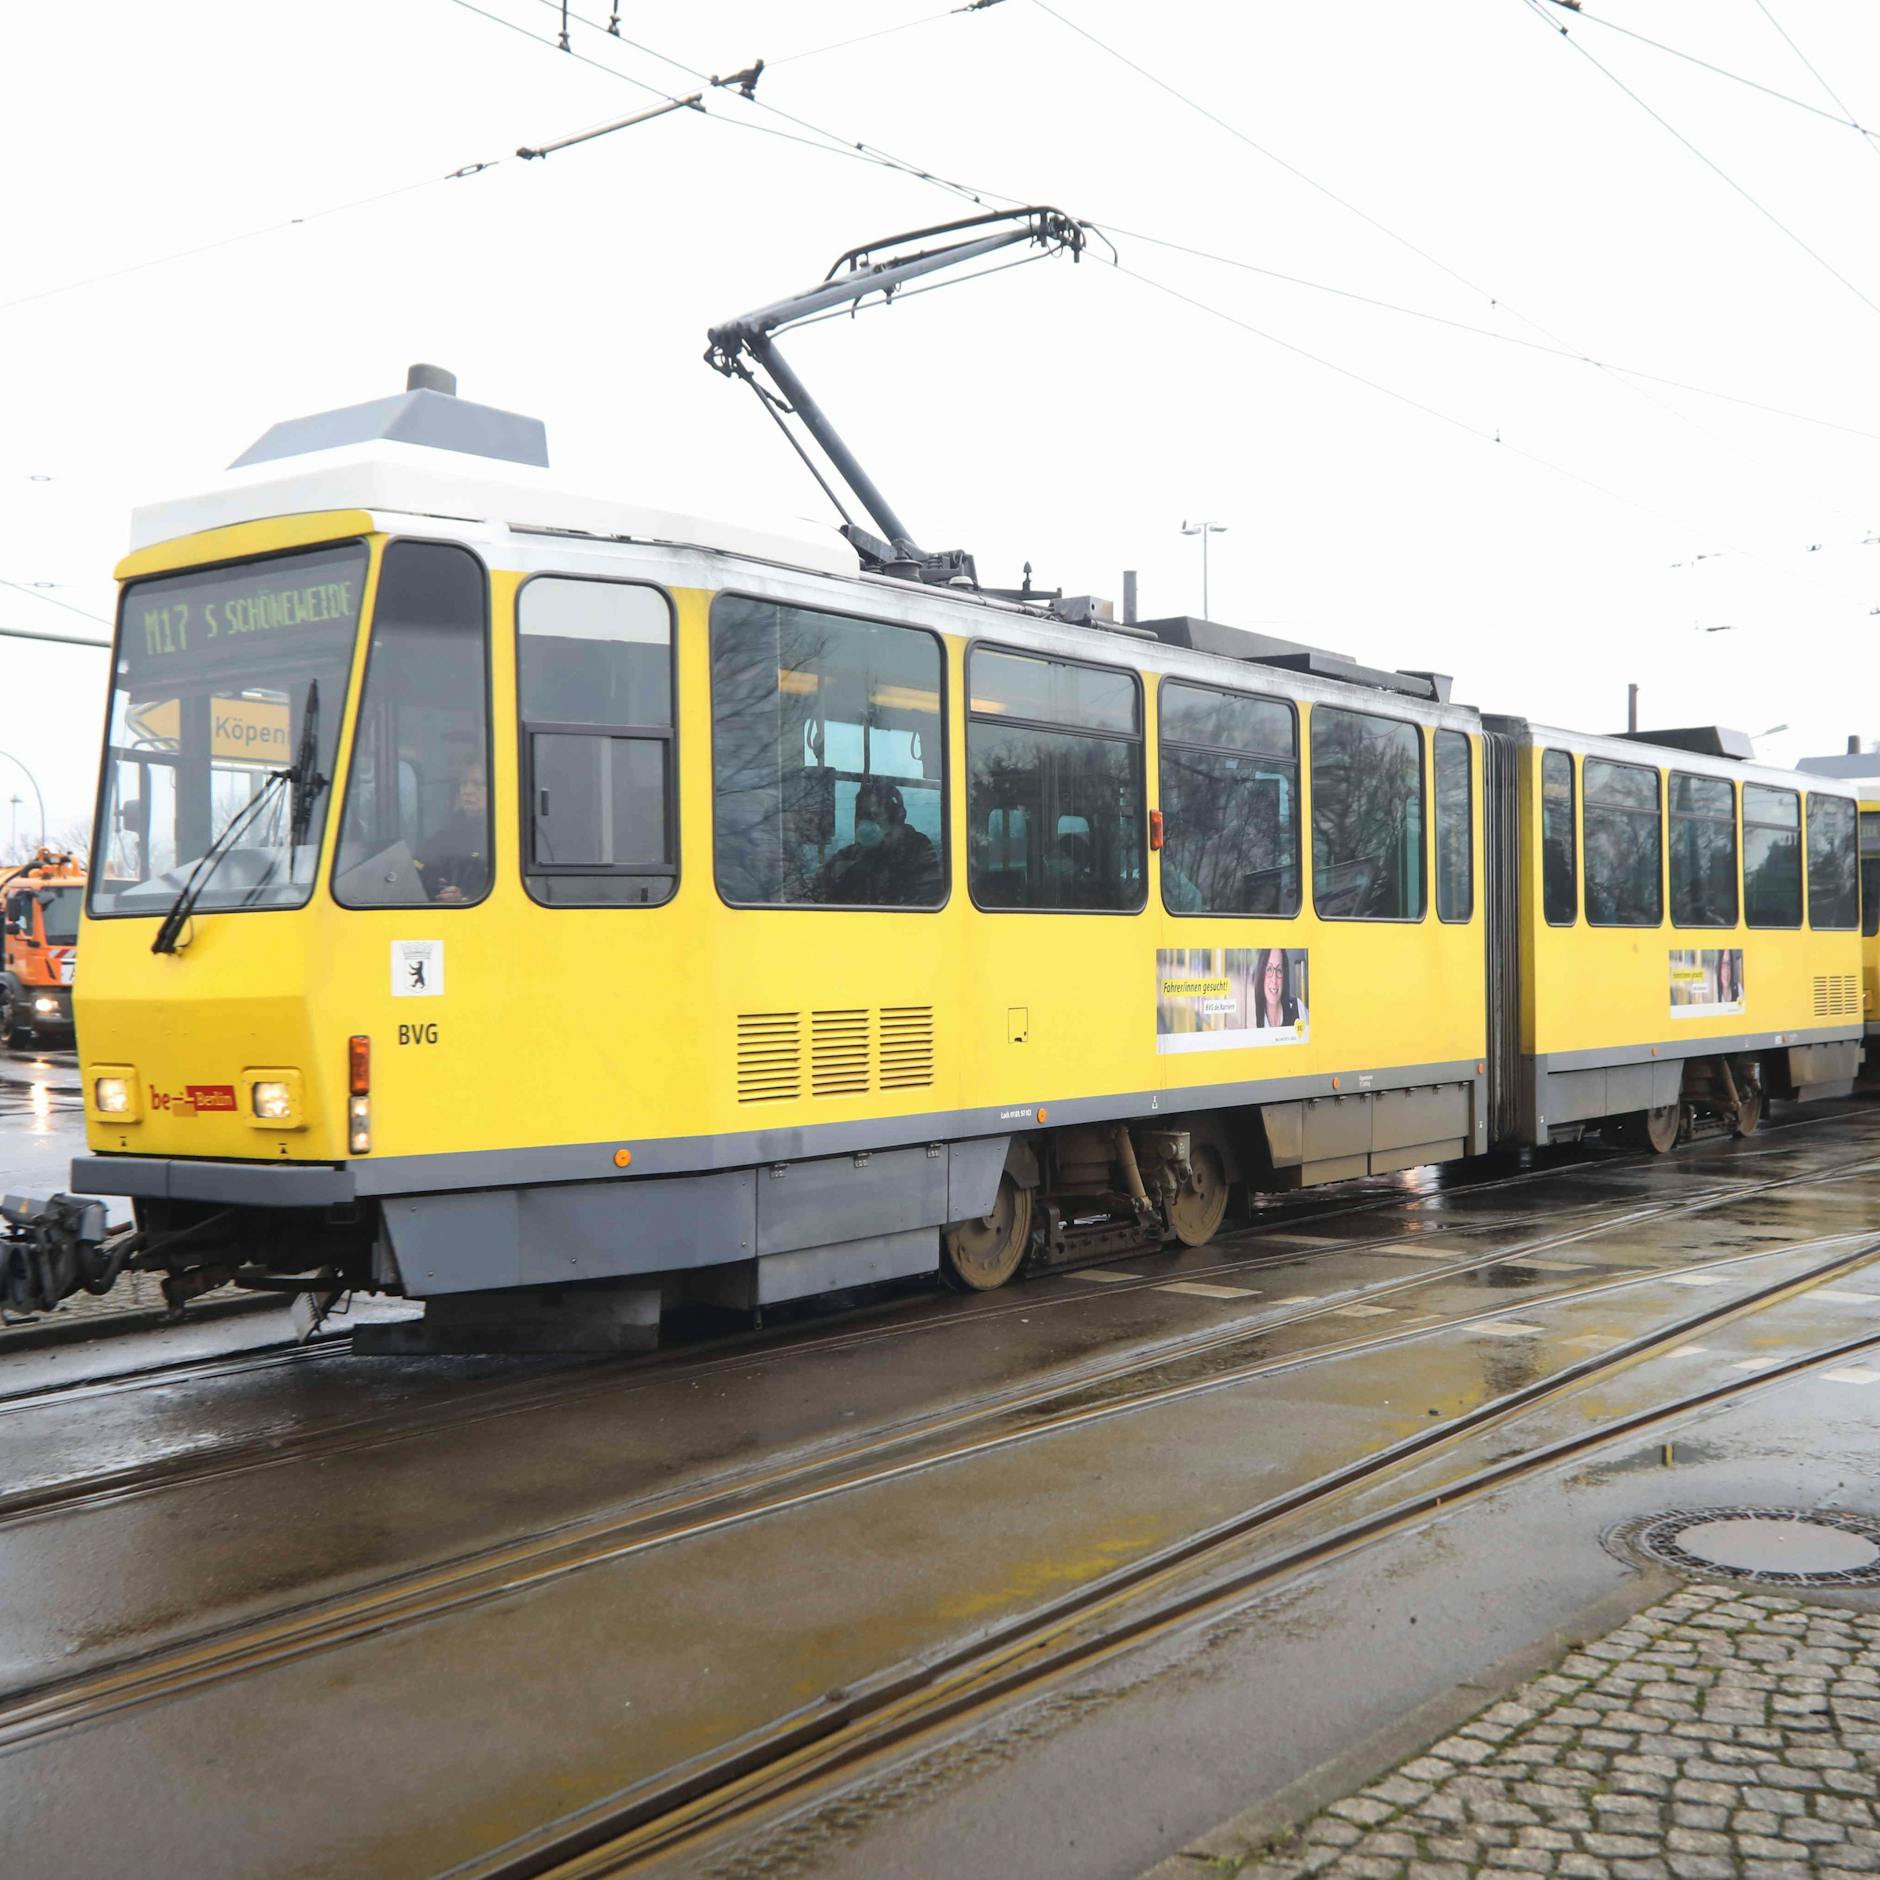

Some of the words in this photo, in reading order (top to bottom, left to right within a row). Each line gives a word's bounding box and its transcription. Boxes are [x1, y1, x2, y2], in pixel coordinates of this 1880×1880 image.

[144, 603, 189, 656] M17
[205, 604, 219, 638] S
[224, 581, 355, 635] SCHÖNEWEIDE
[398, 1022, 439, 1045] BVG
